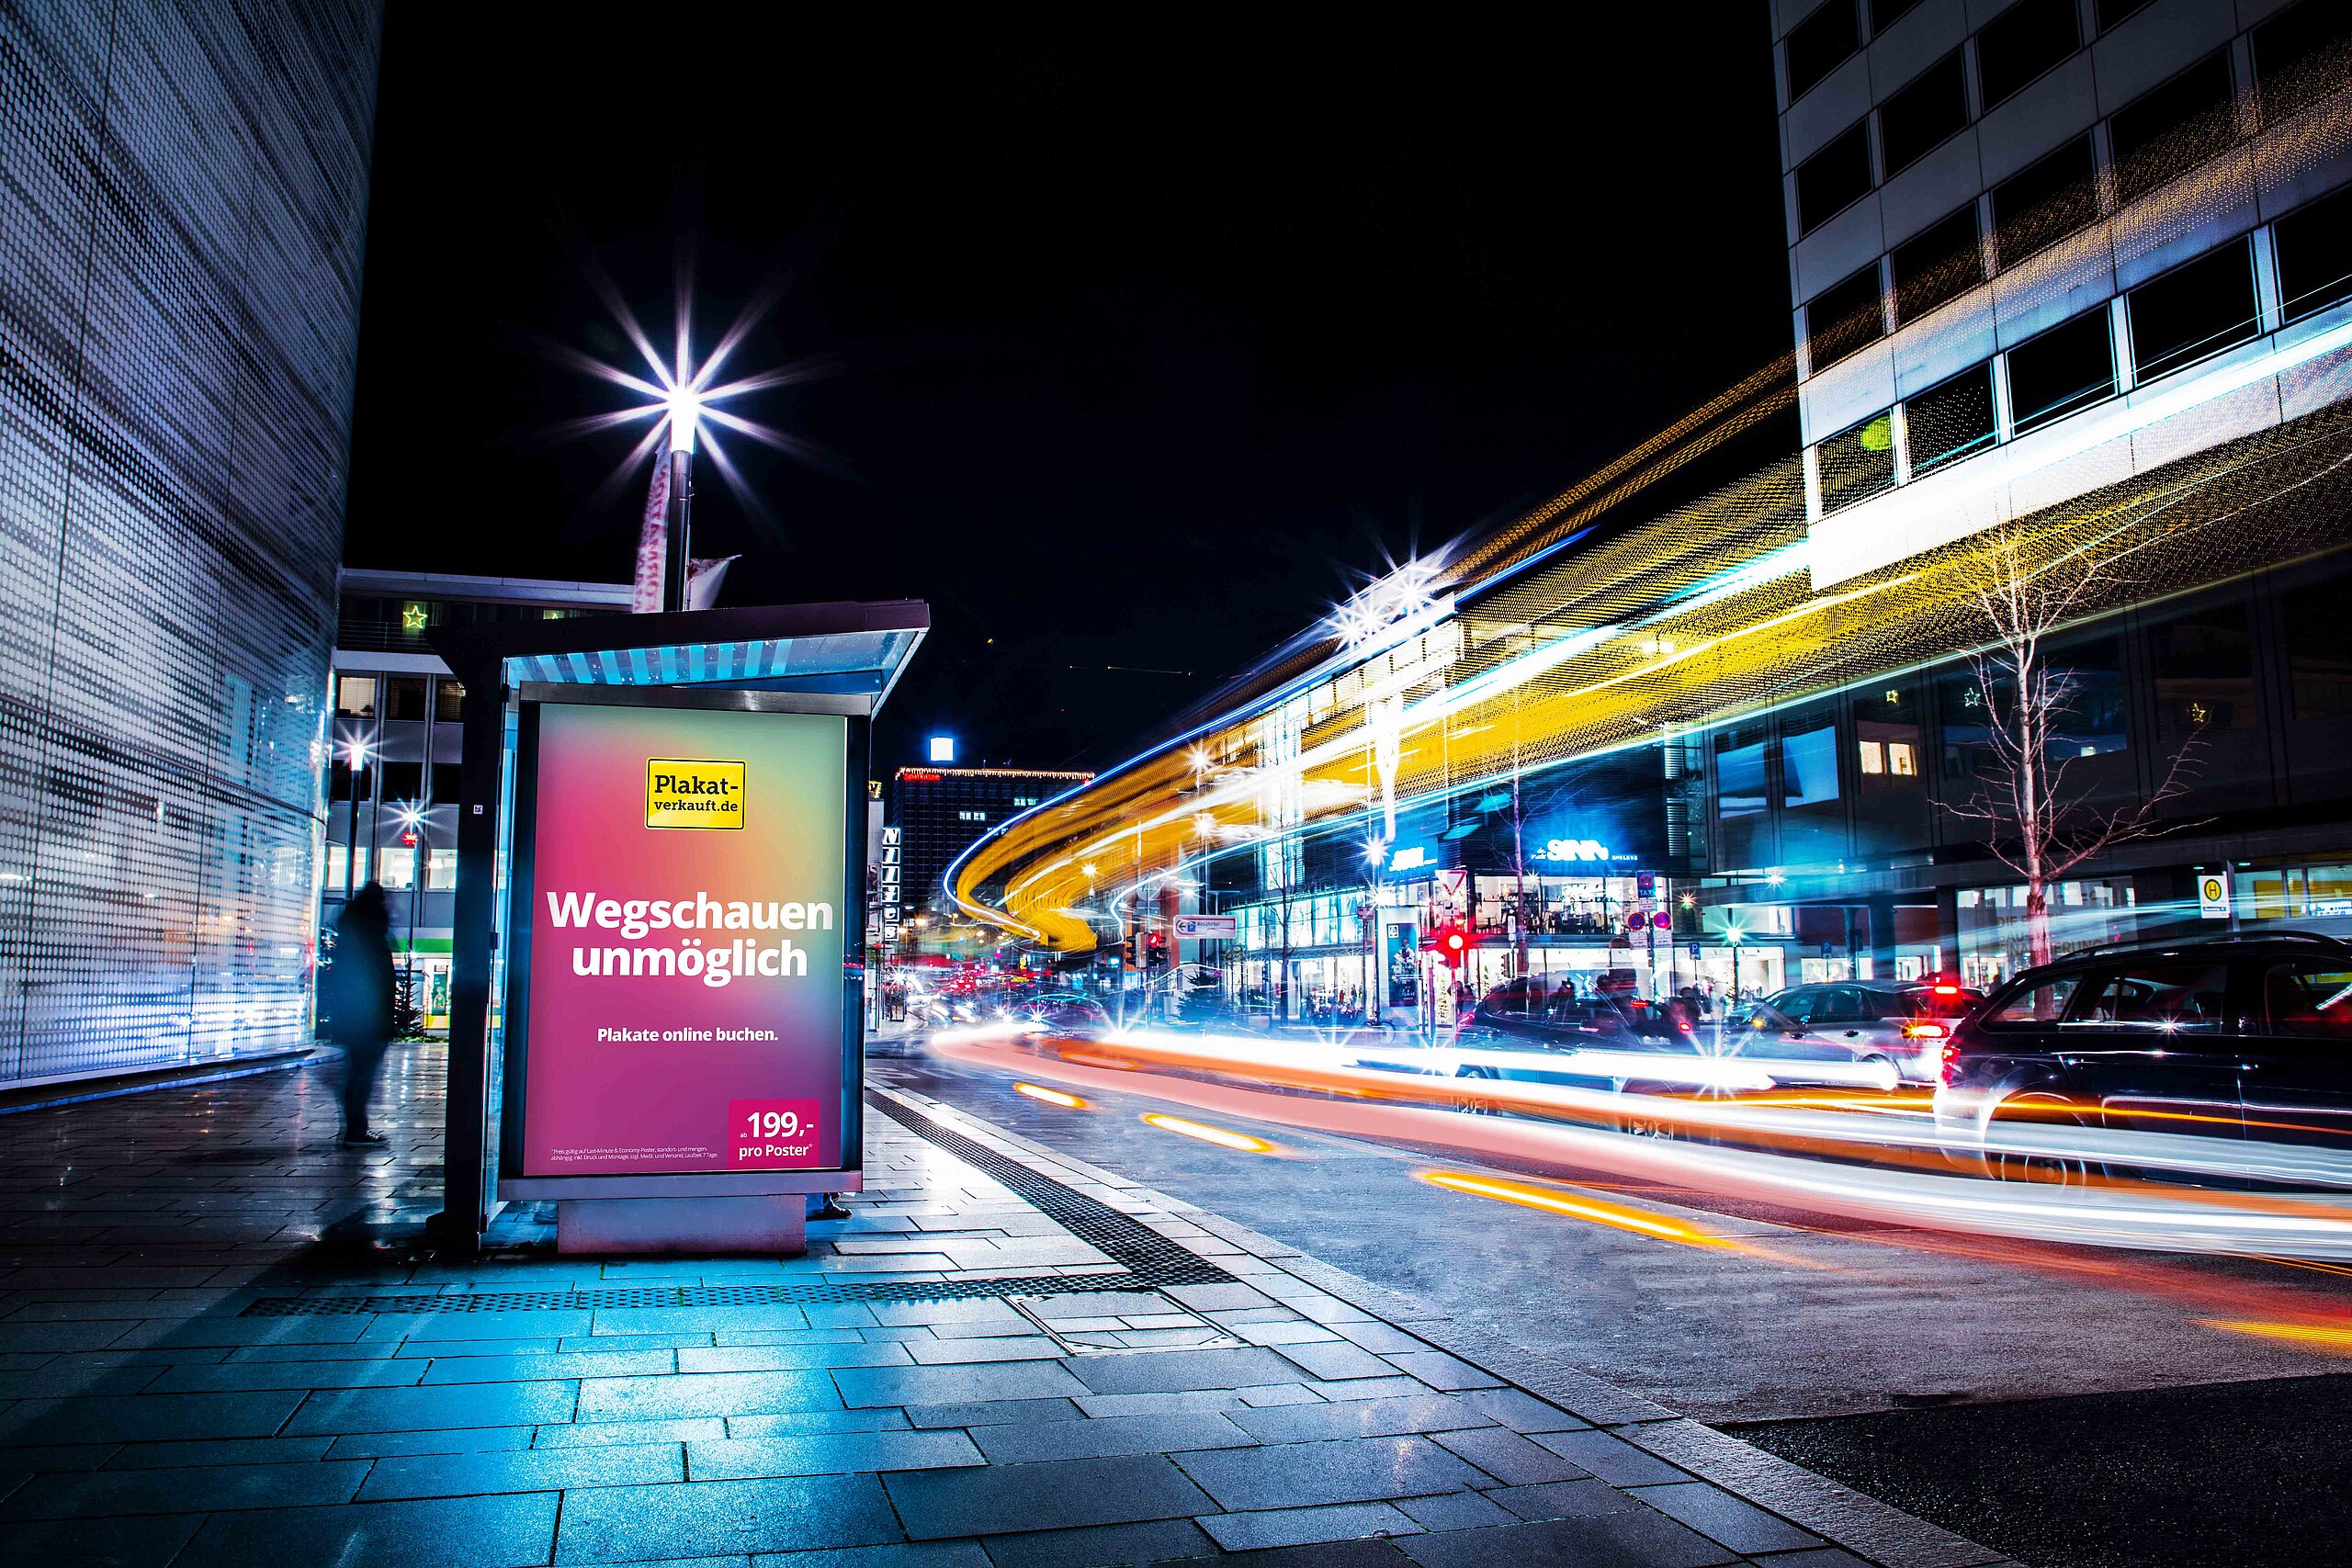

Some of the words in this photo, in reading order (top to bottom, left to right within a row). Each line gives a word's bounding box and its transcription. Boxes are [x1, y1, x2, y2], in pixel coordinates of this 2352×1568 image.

[654, 775, 739, 795] Plakat-
[654, 799, 739, 812] verkauft.de
[547, 891, 833, 940] Wegschauen
[572, 938, 808, 987] unmöglich
[597, 1027, 659, 1042] Plakate
[662, 1027, 713, 1042] online
[716, 1027, 779, 1042] buchen.
[747, 1111, 814, 1138] 199,-
[739, 1146, 763, 1161] pro
